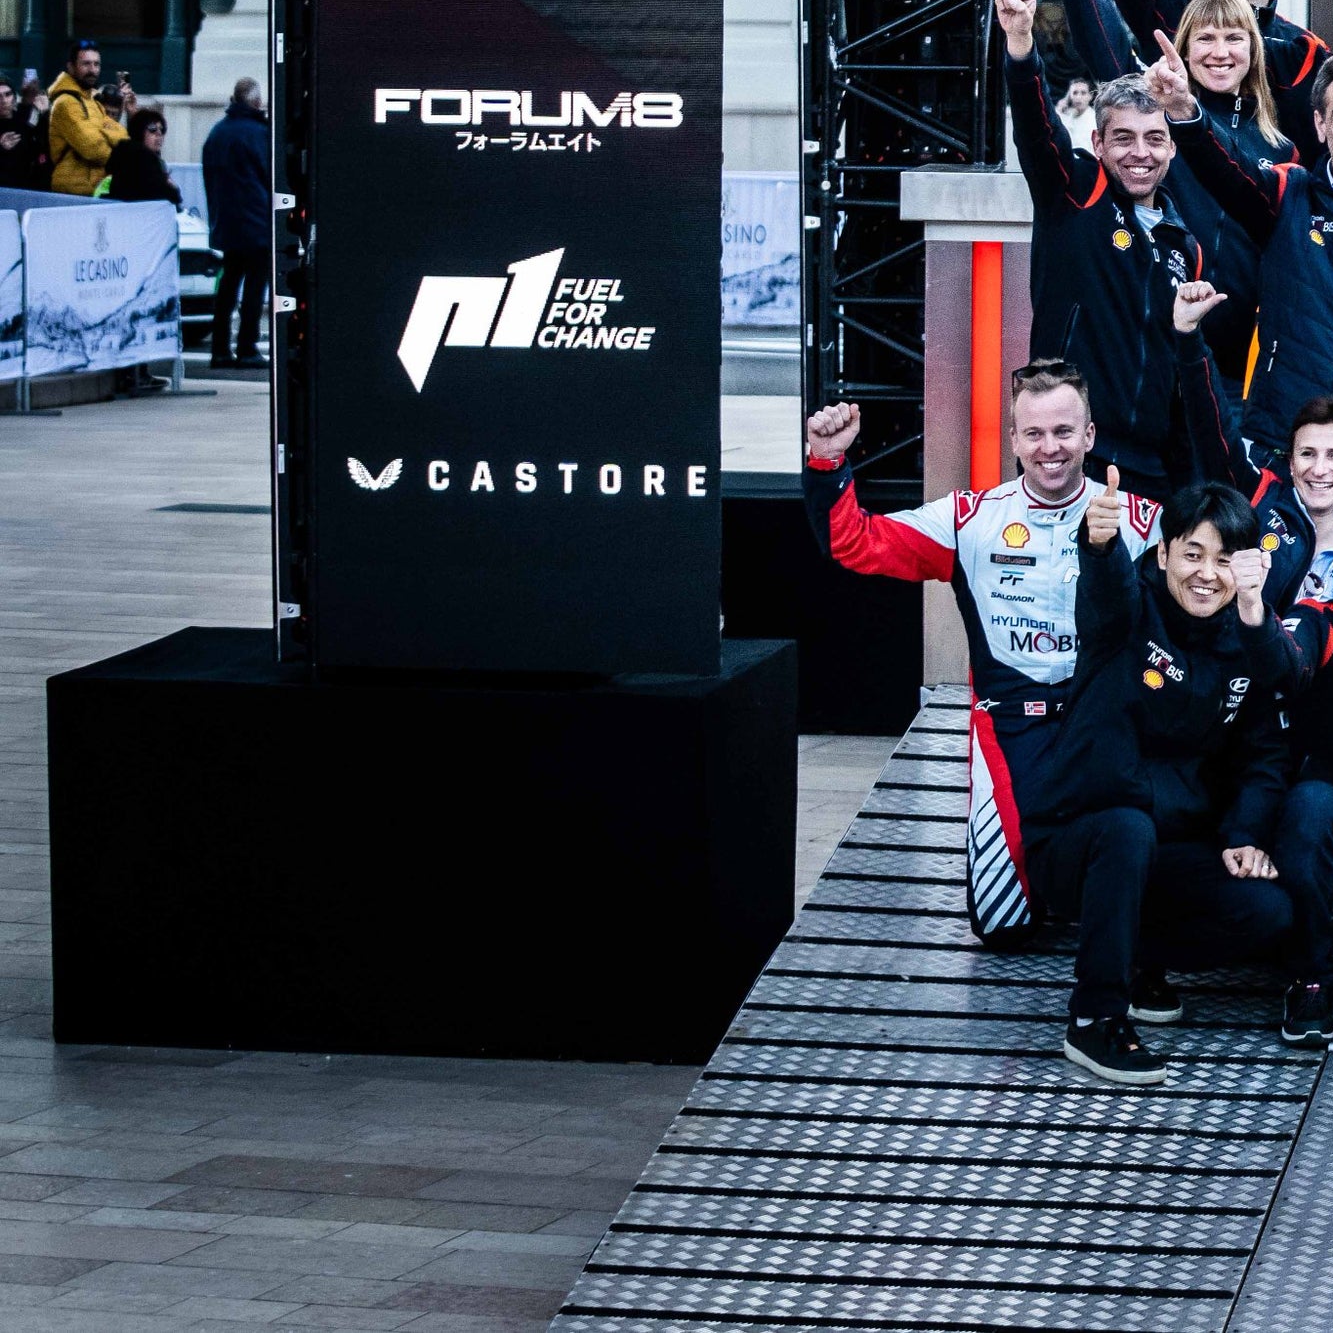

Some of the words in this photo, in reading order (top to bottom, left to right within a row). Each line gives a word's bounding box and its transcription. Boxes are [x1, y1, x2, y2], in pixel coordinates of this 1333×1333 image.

[374, 87, 684, 129] FORUM8
[456, 130, 602, 152] フォーラムエイト
[723, 224, 768, 245] SINO
[87, 255, 129, 281] CASINO
[554, 278, 625, 301] FUEL
[547, 302, 605, 325] FOR
[537, 326, 656, 350] CHANGE
[427, 460, 708, 497] CASTORE
[990, 591, 1036, 603] SALOMON
[991, 614, 1056, 633] HYUNDAI
[1147, 640, 1174, 663] HYUNDAI
[1147, 650, 1186, 683] MOBIS
